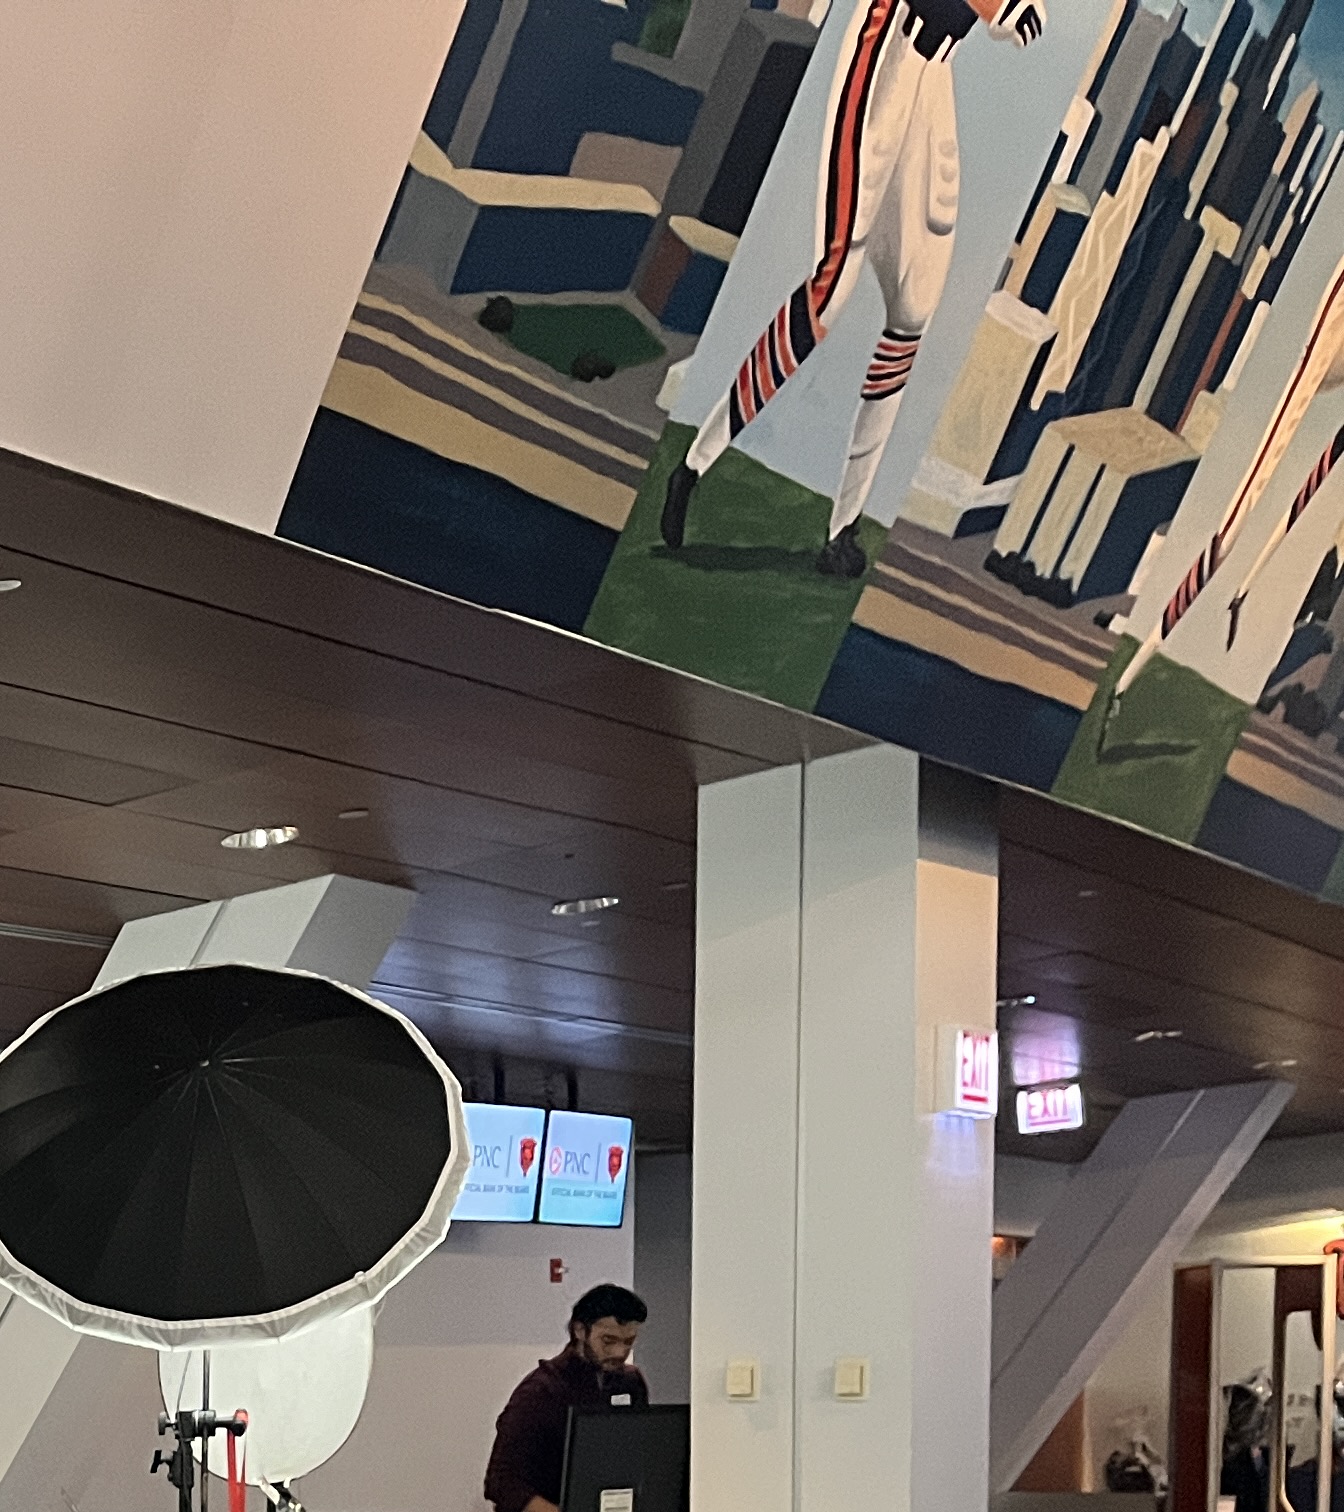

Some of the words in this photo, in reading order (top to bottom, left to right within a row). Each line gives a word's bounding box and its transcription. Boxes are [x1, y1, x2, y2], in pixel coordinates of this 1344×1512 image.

[962, 1032, 989, 1091] EXIT
[1027, 1087, 1069, 1120] EXIT
[473, 1144, 502, 1168] PNC
[563, 1150, 591, 1175] PNC
